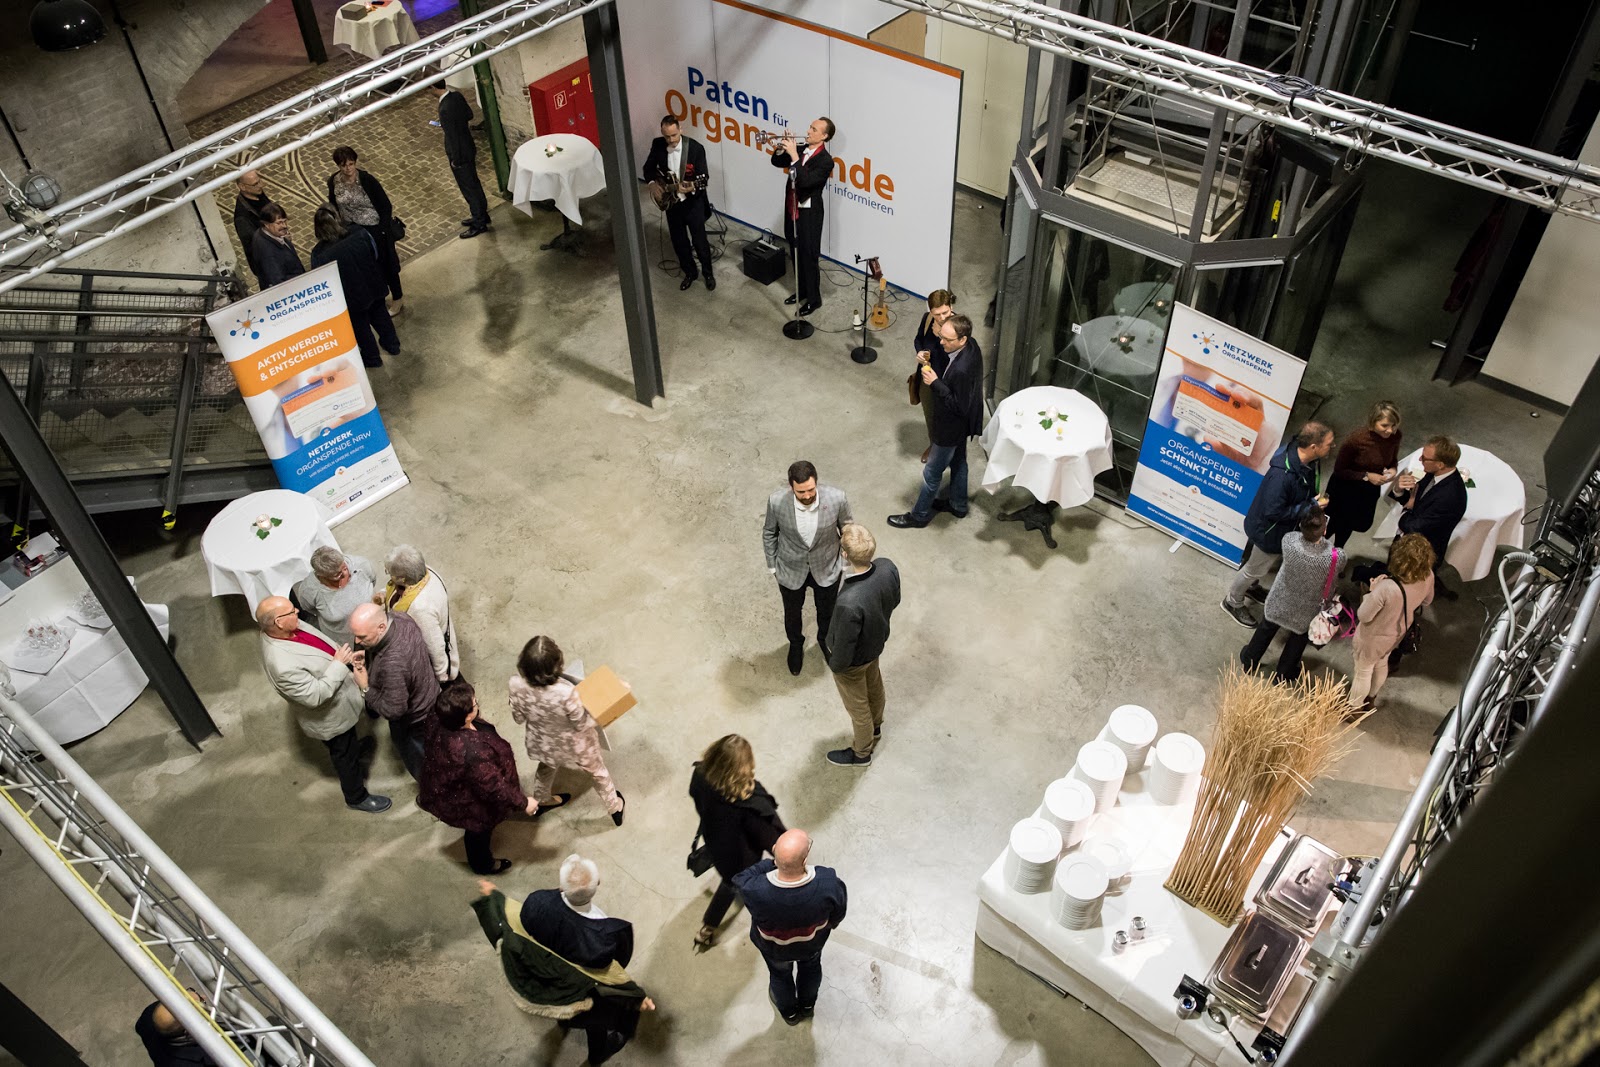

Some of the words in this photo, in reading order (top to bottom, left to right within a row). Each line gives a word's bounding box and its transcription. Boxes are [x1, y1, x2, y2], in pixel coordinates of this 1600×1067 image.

[687, 66, 769, 121] Paten
[773, 112, 789, 127] für
[664, 88, 895, 201] Organsnde
[834, 184, 894, 215] informieren
[265, 281, 330, 313] NETZWERK
[269, 291, 333, 321] ORGANSPENDE
[257, 349, 287, 370] AKTIV
[288, 329, 333, 353] WERDEN
[259, 372, 268, 382] &
[269, 339, 339, 377] ENTSCHEIDEN
[1221, 349, 1272, 377] ORGANSPENDE
[1223, 341, 1274, 370] NETZWERK
[296, 440, 351, 476] ORGANSPENDE
[352, 431, 371, 444] NRW
[308, 430, 353, 458] NETZWERK
[1167, 439, 1241, 481] ORGANSPENDE
[1160, 447, 1208, 475] SCHENKT
[1208, 471, 1243, 493] LEBEN
[1173, 463, 1184, 473] aktiv
[1184, 470, 1203, 482] werden
[1207, 480, 1238, 499] entscheiden
